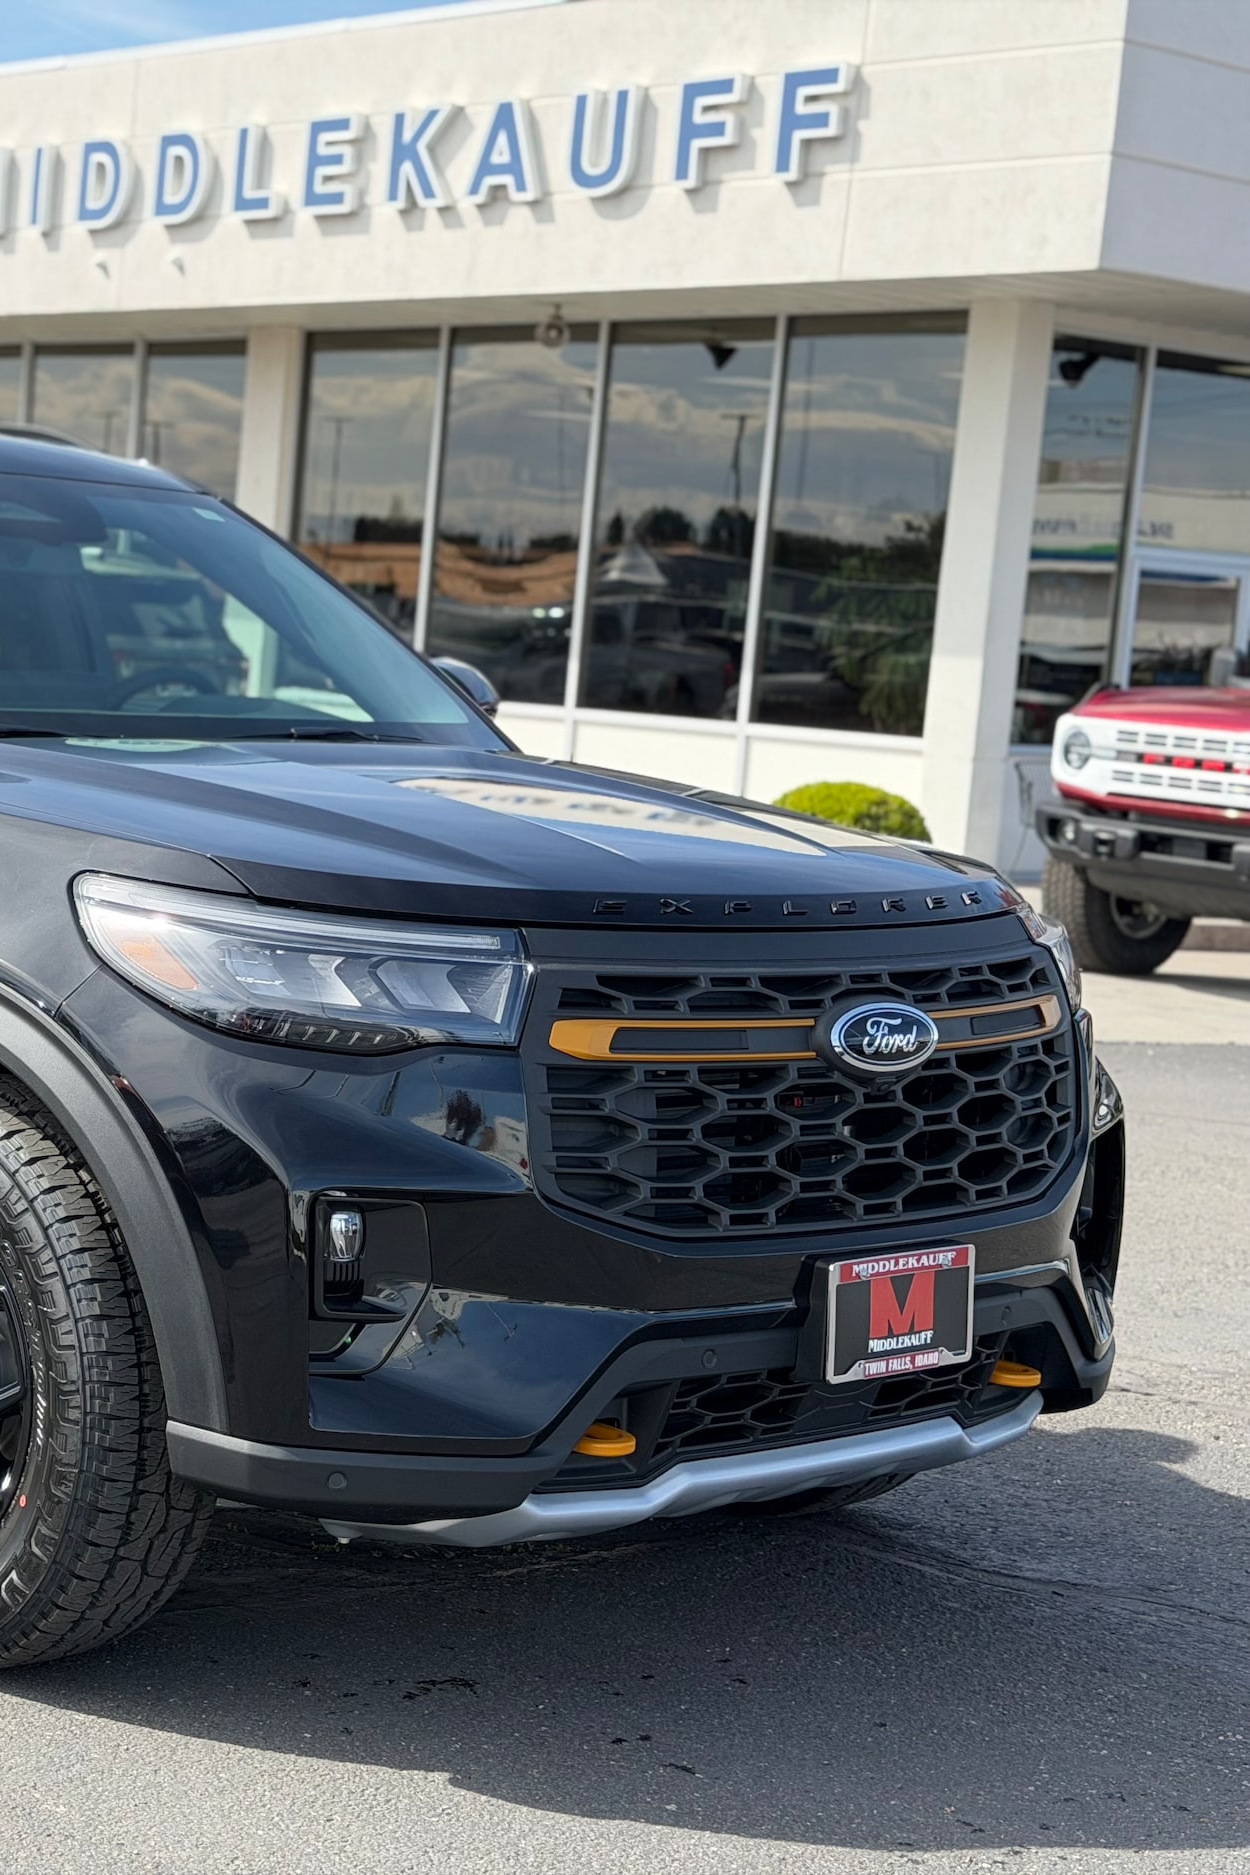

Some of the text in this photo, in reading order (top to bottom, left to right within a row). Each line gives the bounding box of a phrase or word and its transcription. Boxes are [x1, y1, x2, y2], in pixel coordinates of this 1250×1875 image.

[592, 890, 983, 915] EXPLORER
[863, 1017, 920, 1055] Ford
[869, 1270, 935, 1339] M
[868, 1330, 934, 1353] MIDDLEKAUFF
[864, 1350, 939, 1376] TWIN FALLS, IDAHO
